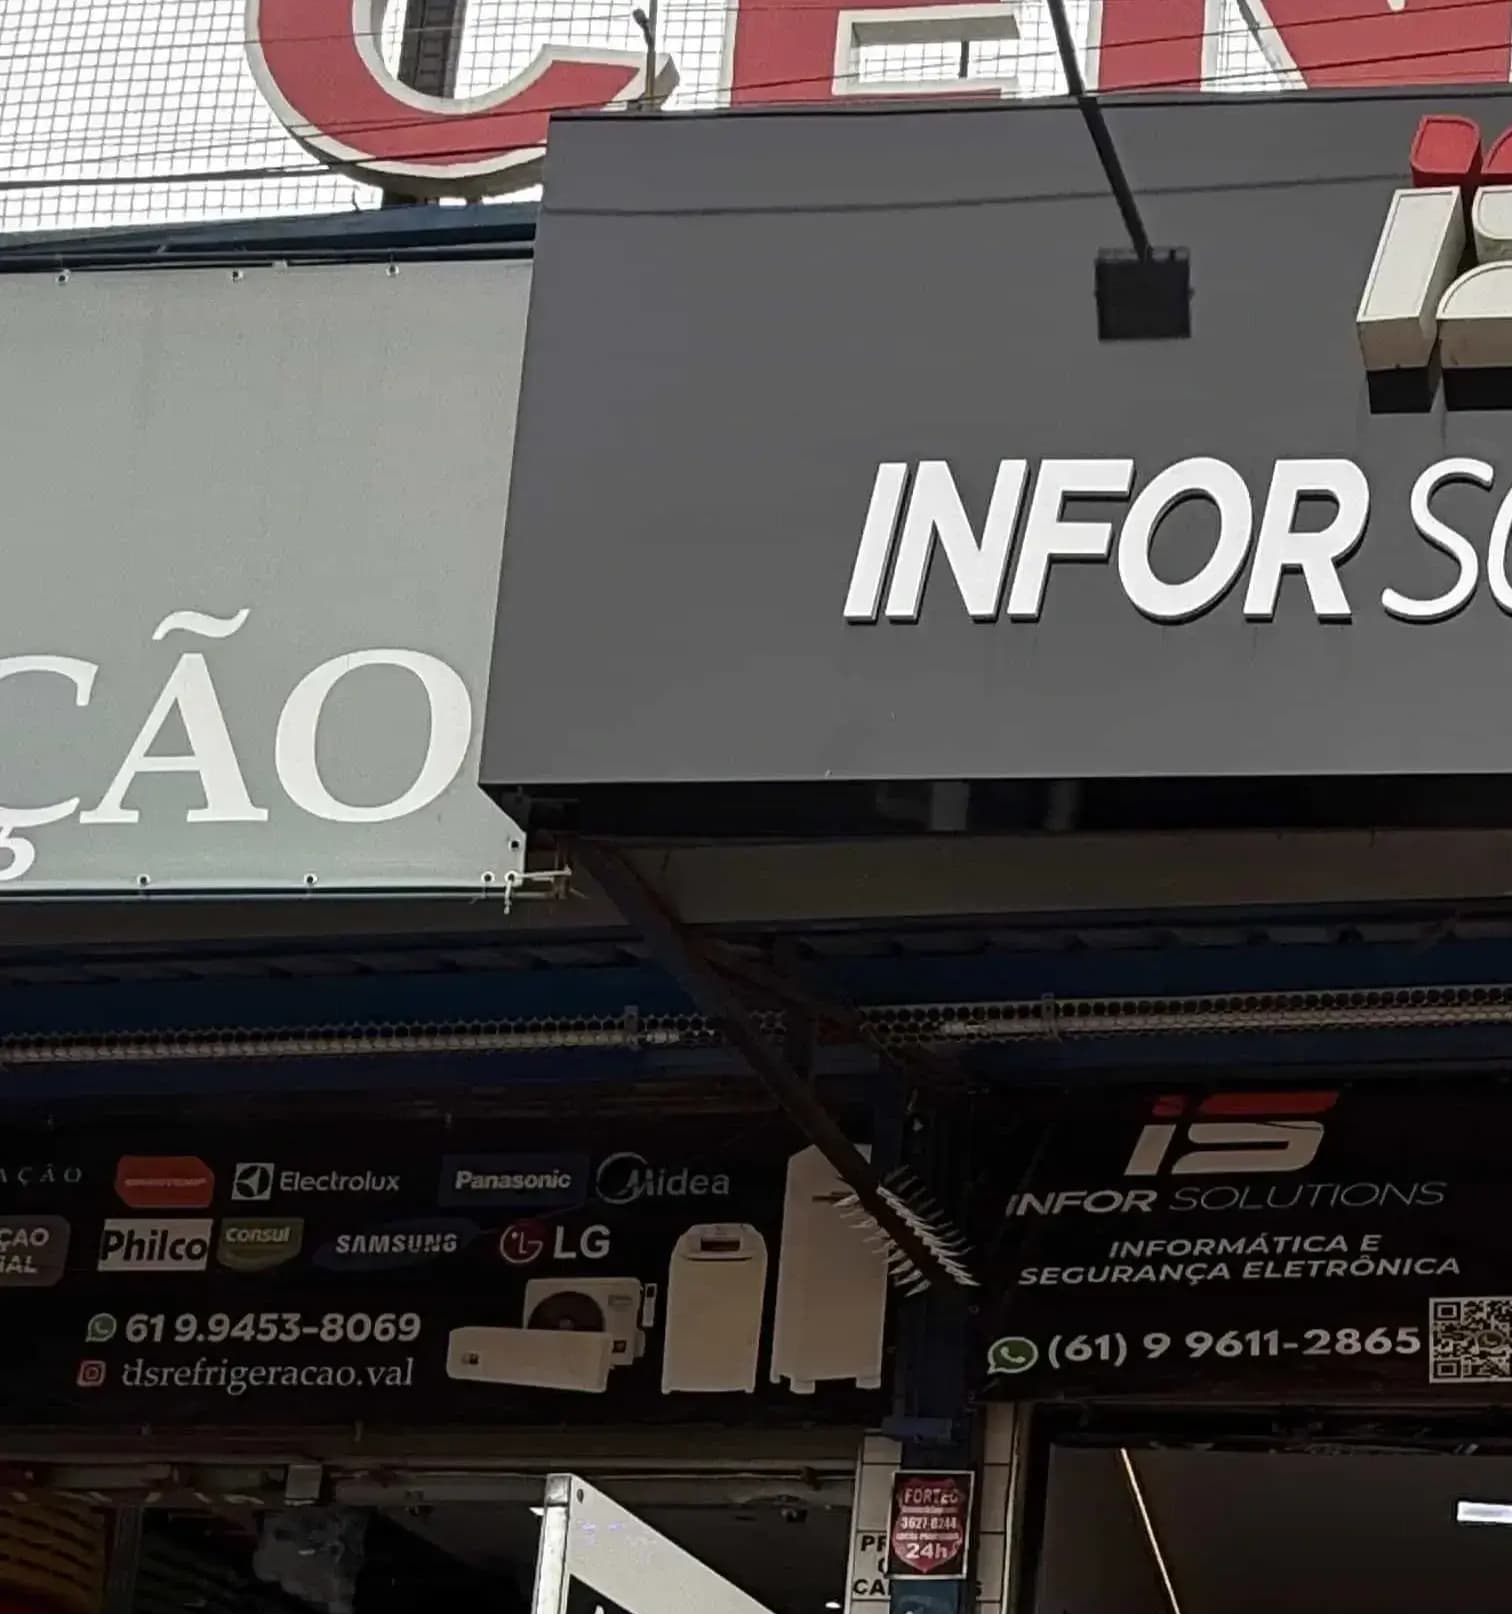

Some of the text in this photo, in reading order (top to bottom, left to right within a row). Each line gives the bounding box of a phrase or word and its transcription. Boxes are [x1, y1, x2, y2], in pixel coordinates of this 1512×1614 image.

[844, 457, 1370, 624] INFOR
[280, 1170, 400, 1192] Electrolux
[455, 1169, 573, 1191] Panasonic
[617, 1165, 731, 1198] Midea
[1006, 1181, 1449, 1217] INFOR SOLUTIONS
[101, 1229, 208, 1262] Philco
[336, 1233, 457, 1254] SAMSUNG
[553, 1225, 611, 1260] LG
[1108, 1231, 1382, 1259] INFORMÁTICA E
[1017, 1254, 1461, 1287] SEGURANÇA ELETRÔNICA
[125, 1313, 421, 1343] 61 9.9453-8069
[1048, 1327, 1421, 1369] (61) 9 9611-2865
[122, 1357, 414, 1396] dsrefrigeracao.val
